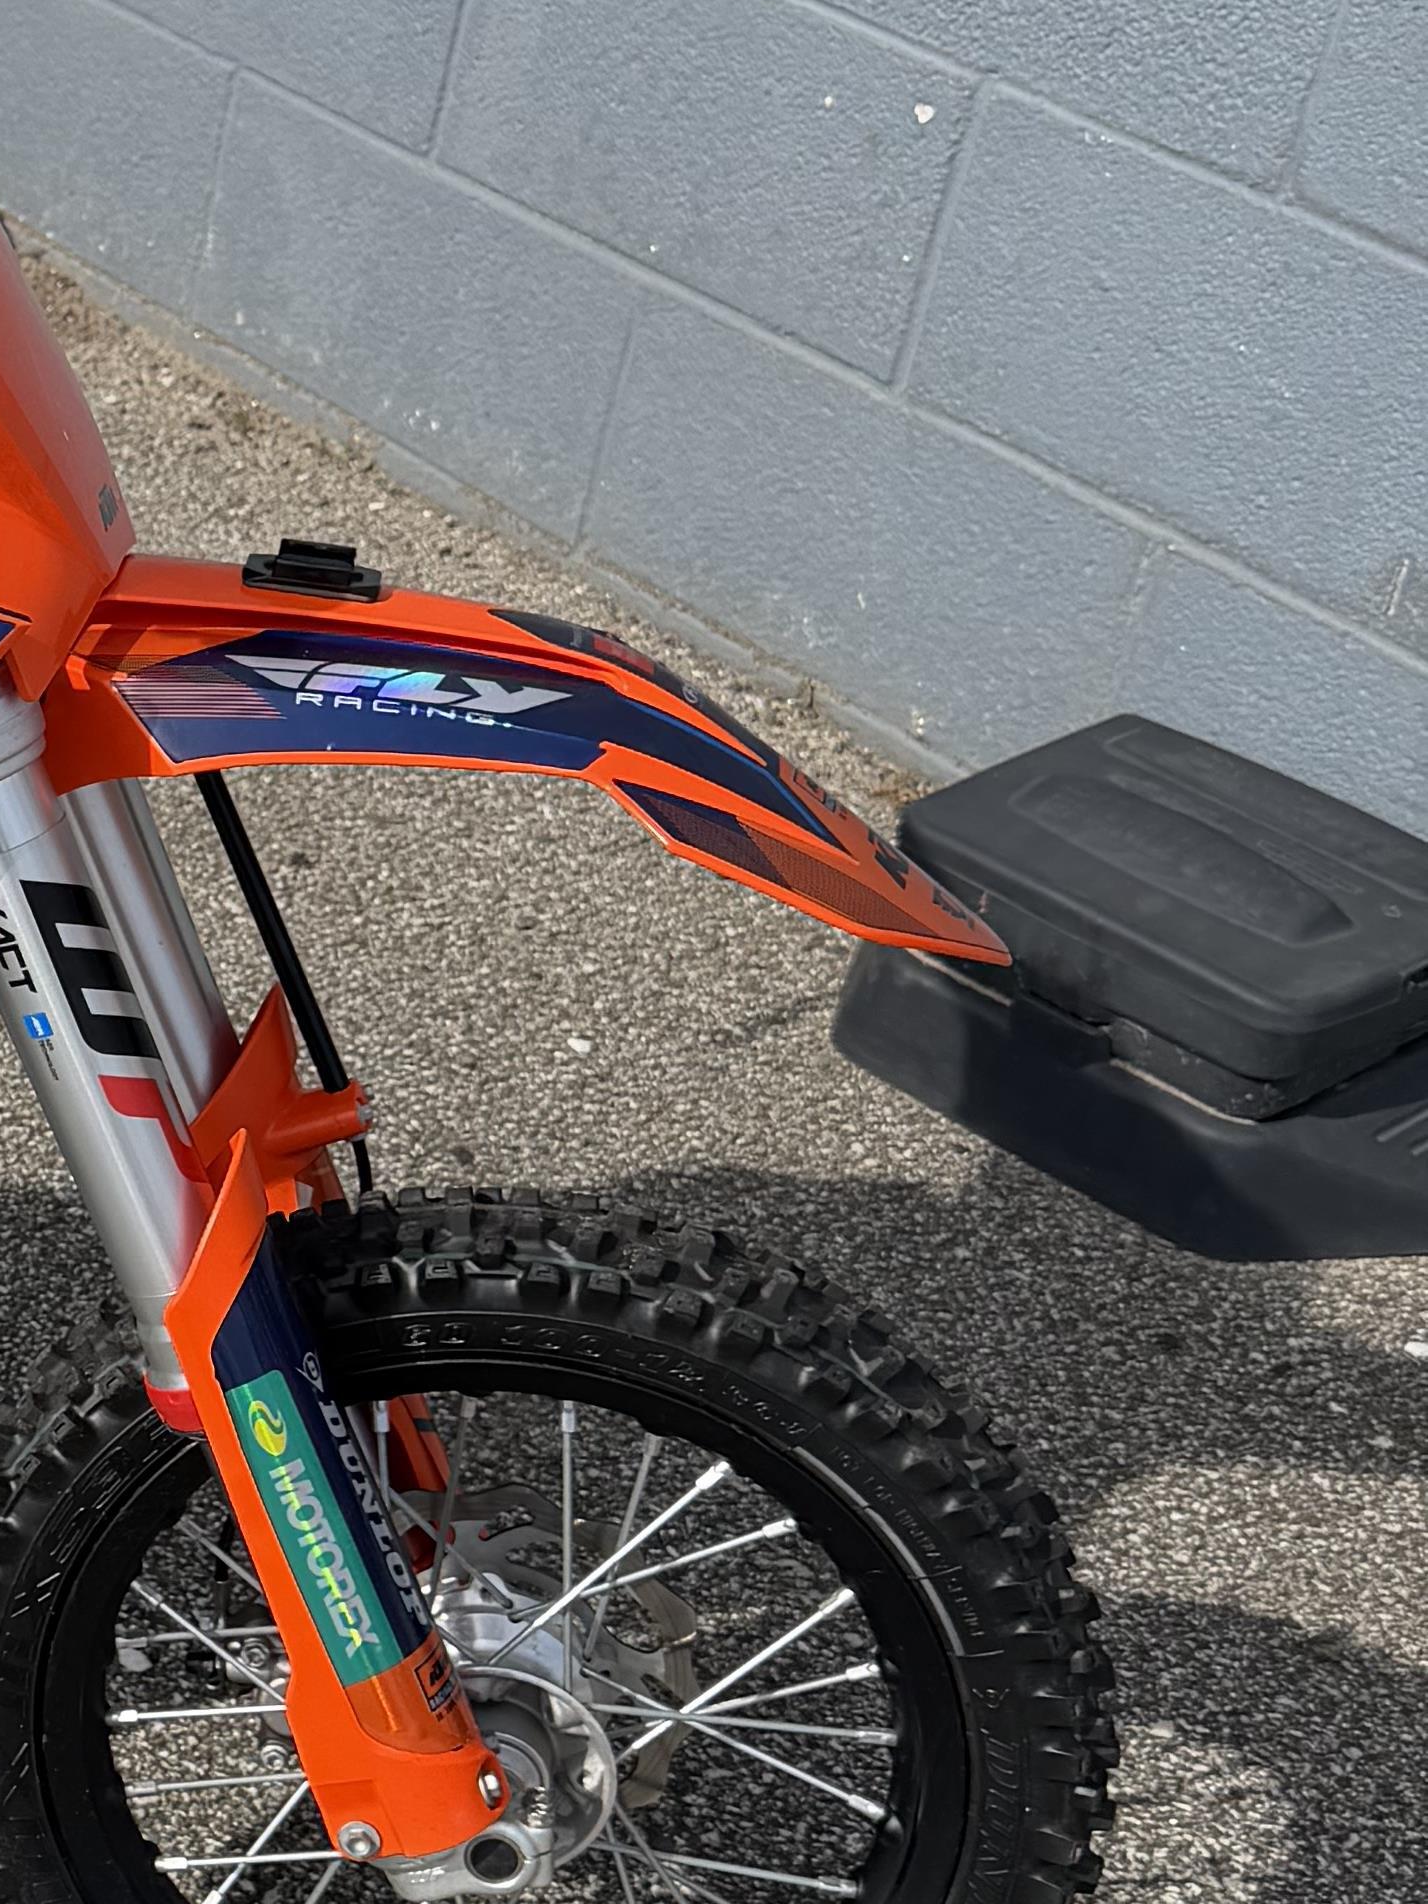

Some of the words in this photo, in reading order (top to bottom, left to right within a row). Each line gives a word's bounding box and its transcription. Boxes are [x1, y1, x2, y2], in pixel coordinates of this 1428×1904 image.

[234, 654, 572, 713] FLY
[270, 1458, 380, 1658] MOTOREX
[316, 1398, 429, 1626] DUNLOP
